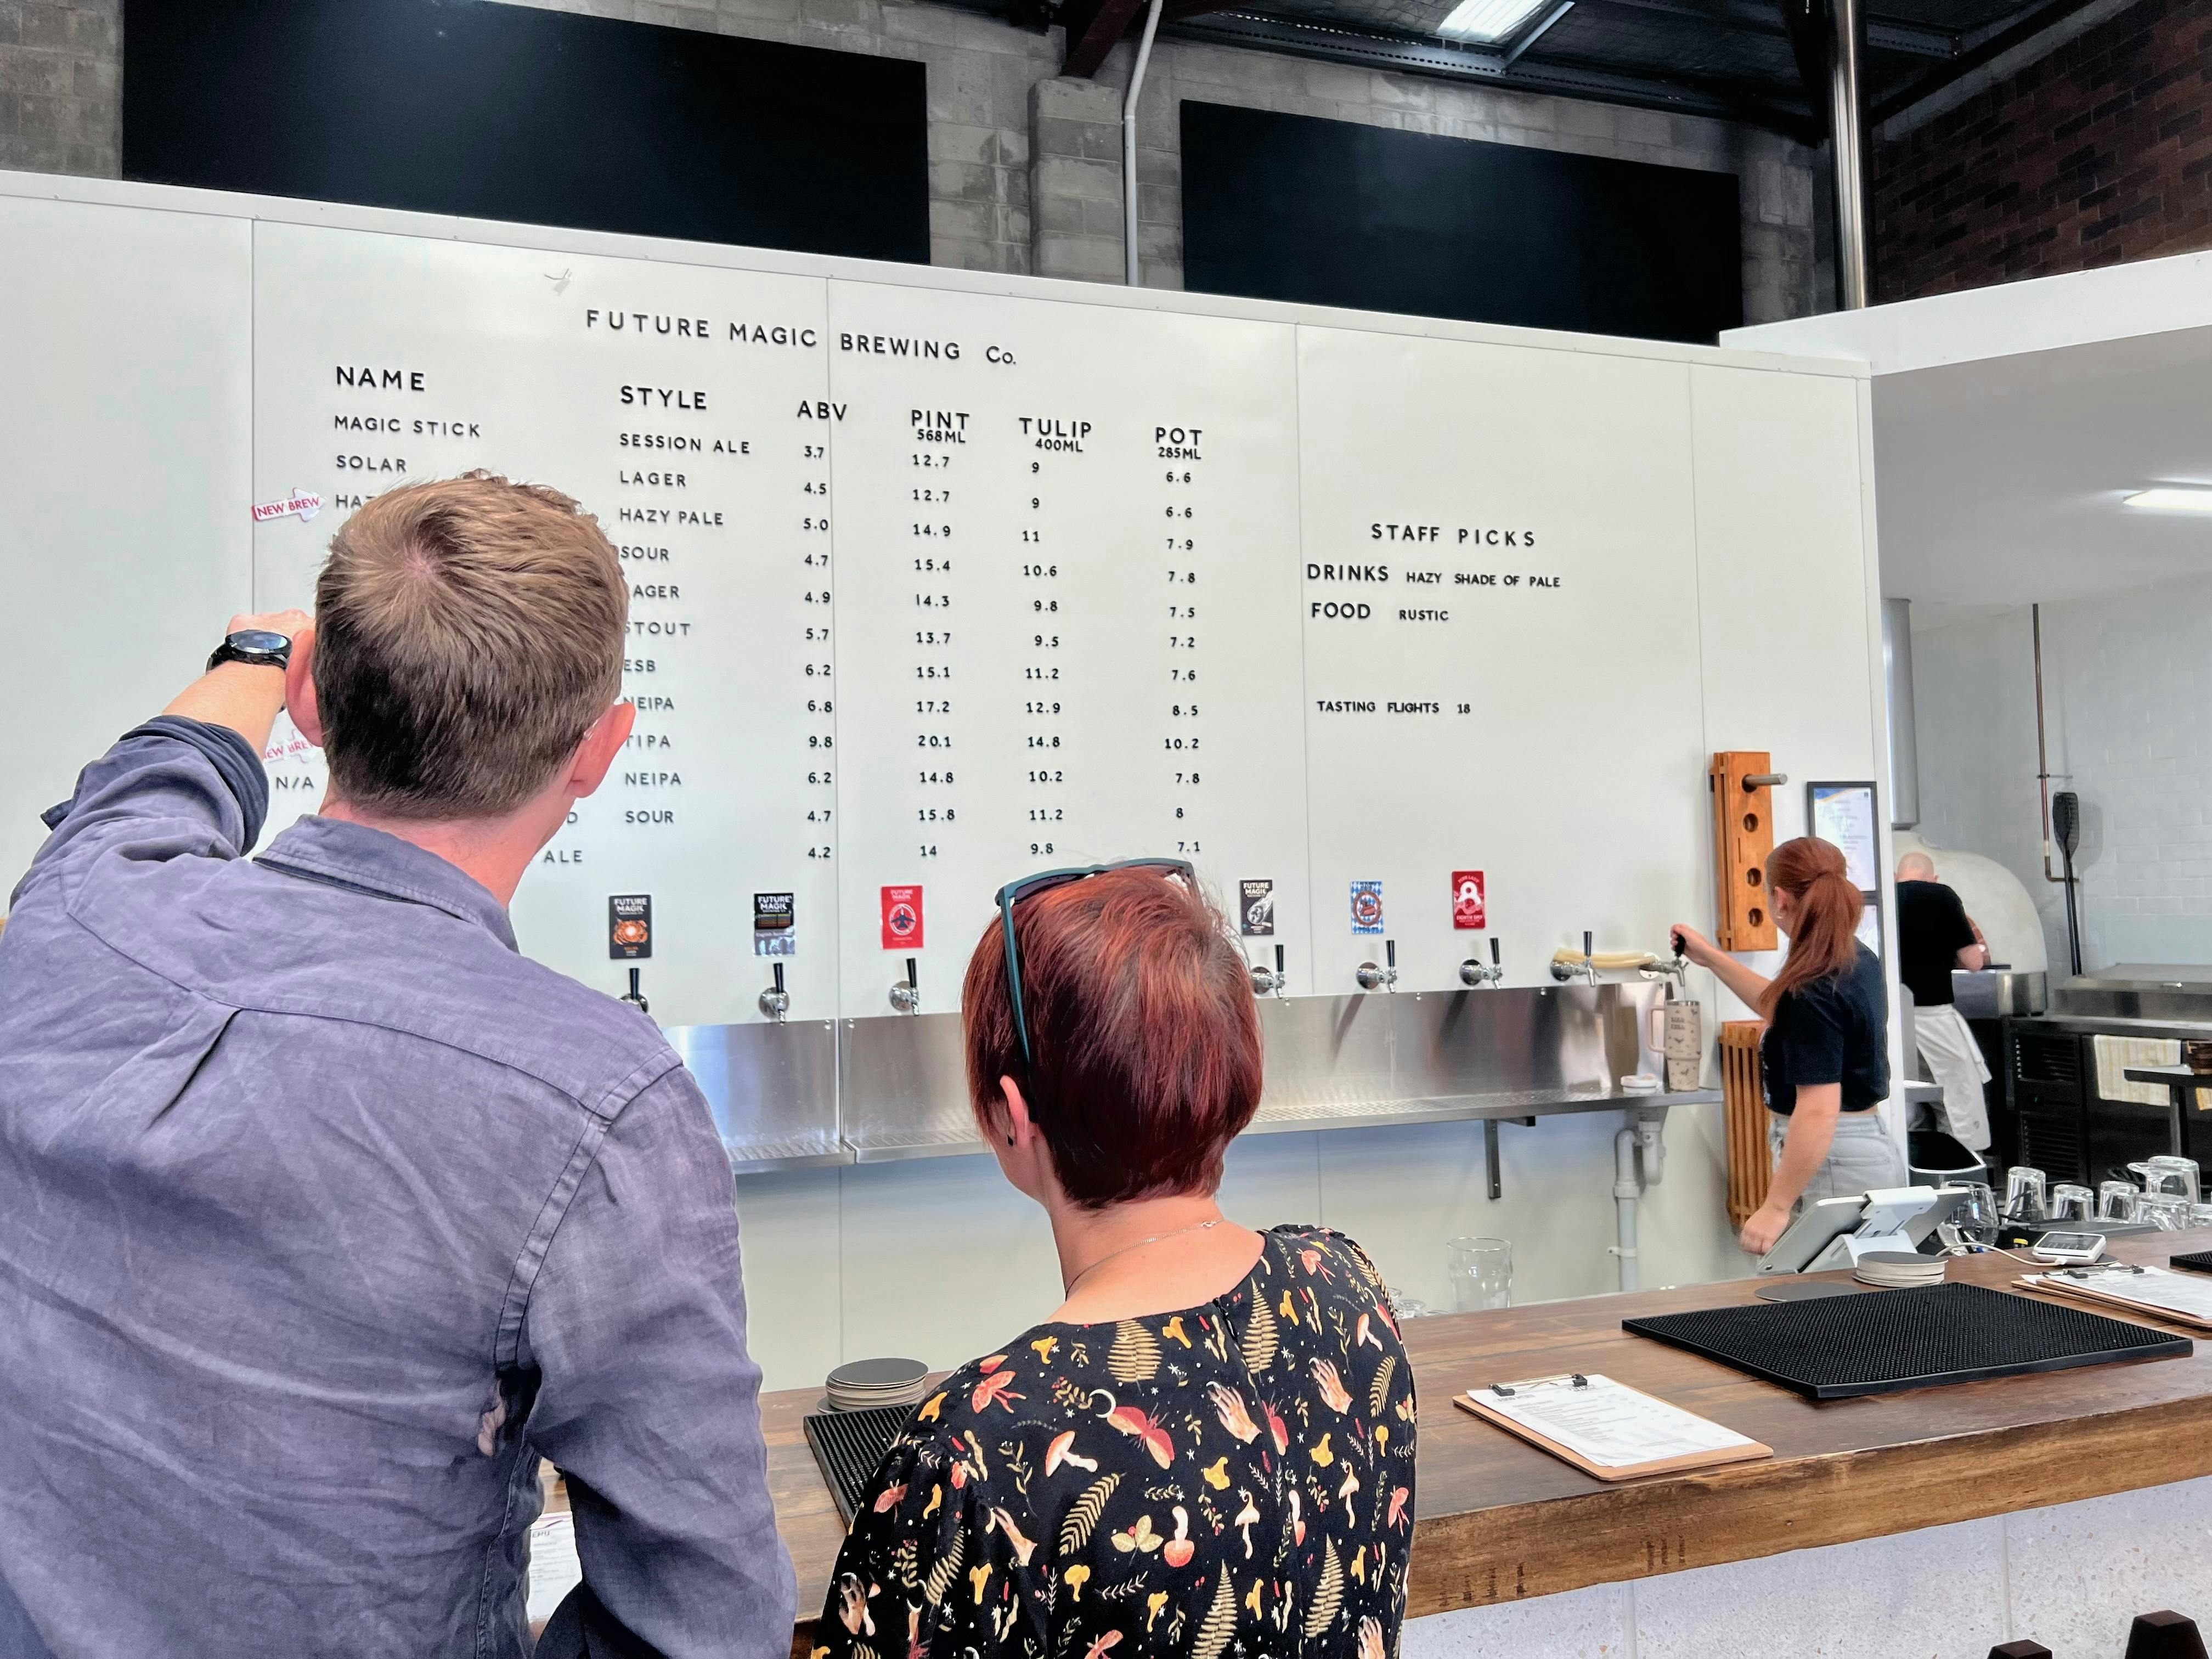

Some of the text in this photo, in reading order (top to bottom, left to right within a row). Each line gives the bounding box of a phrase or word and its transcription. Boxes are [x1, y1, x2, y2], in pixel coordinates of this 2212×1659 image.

[587, 309, 1016, 365] FUTURE MAGIC BREWING Co.
[336, 366, 1202, 445] NAME STYLE ABV PINT TULIP POT
[335, 415, 1191, 483] MAGIC STICK SESSION ALE 3.7 12.7 9 6.6
[917, 428, 1201, 460] 568ML 400ML 285ML
[336, 455, 1192, 518] SOLAR LAGER 4.5 12.7 9 6.6
[257, 496, 319, 517] NEW BREW
[620, 508, 670, 523] HAZY
[679, 511, 723, 526] PALE
[803, 518, 828, 531] 5.0
[913, 523, 951, 537] 14.9
[1022, 530, 1040, 542] 11
[1167, 538, 1193, 550] 7.9
[1372, 523, 1534, 547] STAFF PICKS
[620, 546, 1195, 584] SOUR 4.7 15.4 10.6 7.8
[1307, 563, 1560, 588] DRINKS HAZY SHADE OF PALE
[633, 584, 1195, 618] AGER 4.9 14.3 9.8 7.5
[1312, 602, 1449, 621] FOOD RUSTIC
[806, 628, 829, 640] 5.7
[916, 631, 951, 644] 13.7
[1035, 635, 1059, 647] 9.5
[1170, 636, 1194, 648] 7.2
[623, 659, 1195, 681] ESB 6.2 15.1 11.2 7.6
[808, 700, 833, 713] 6.8
[916, 701, 950, 713] 17.2
[1026, 702, 1060, 714] 12.9
[1172, 705, 1198, 716] 8.5
[1316, 701, 1471, 714] TASTING FLIGHTS 18
[266, 741, 313, 759] EW BRE
[809, 736, 833, 748] 9.8
[918, 735, 951, 748] 20.1
[1028, 736, 1060, 748] 14.8
[1165, 738, 1199, 749] 10.2
[276, 771, 1200, 789] N/A NEIPA 6.2 14.8 10.2 7.8
[625, 808, 1183, 823] SOUR 4.7 15.8 11.2 8
[808, 847, 831, 859] 4.2
[920, 845, 937, 857] 14
[1030, 843, 1053, 855] 9.8
[1177, 841, 1200, 852] 7.1
